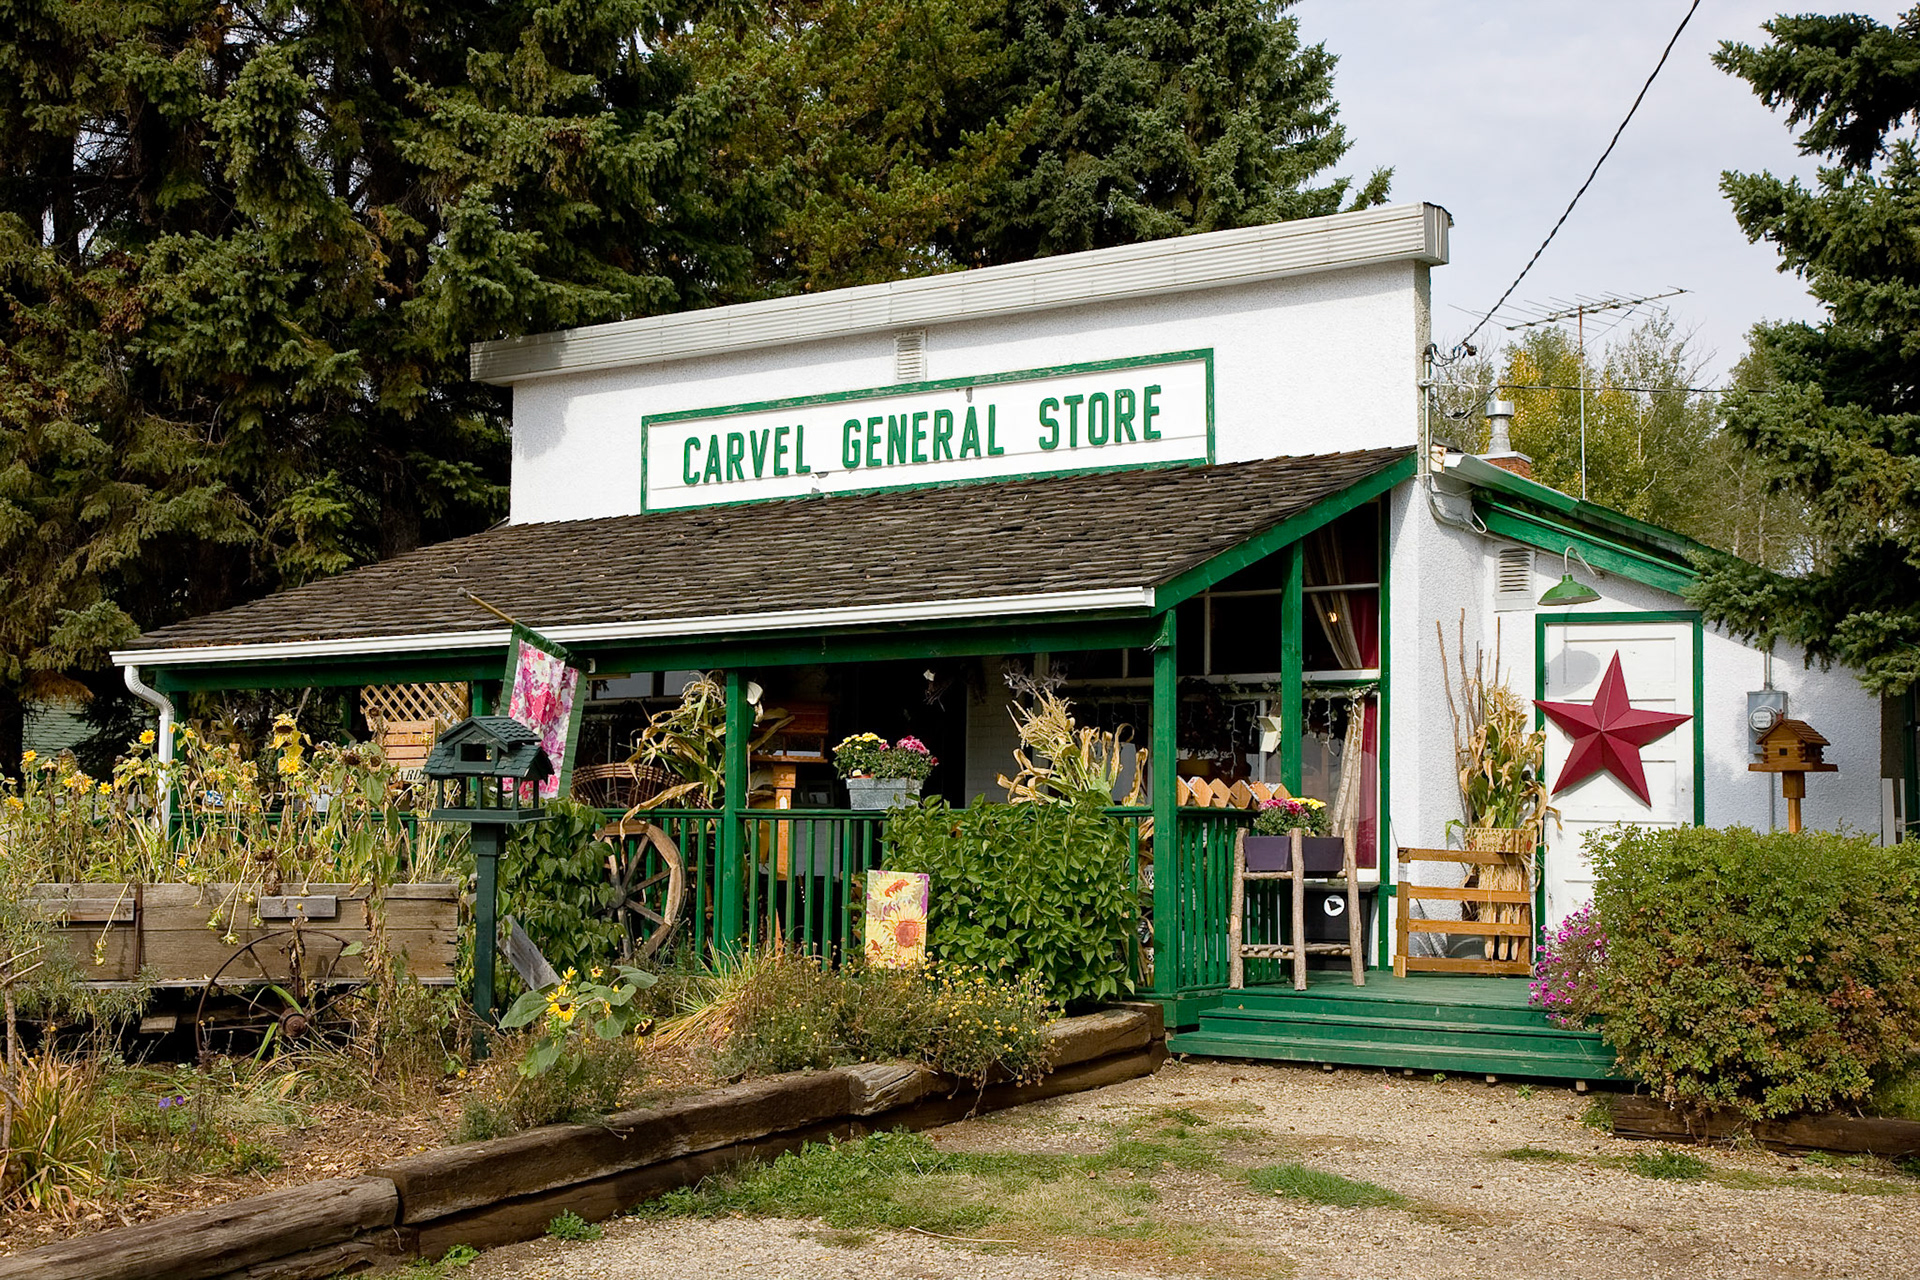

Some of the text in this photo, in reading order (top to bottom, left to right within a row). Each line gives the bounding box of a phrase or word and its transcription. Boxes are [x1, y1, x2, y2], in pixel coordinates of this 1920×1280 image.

[683, 385, 1162, 485] CARVEL GENERAL STORE
